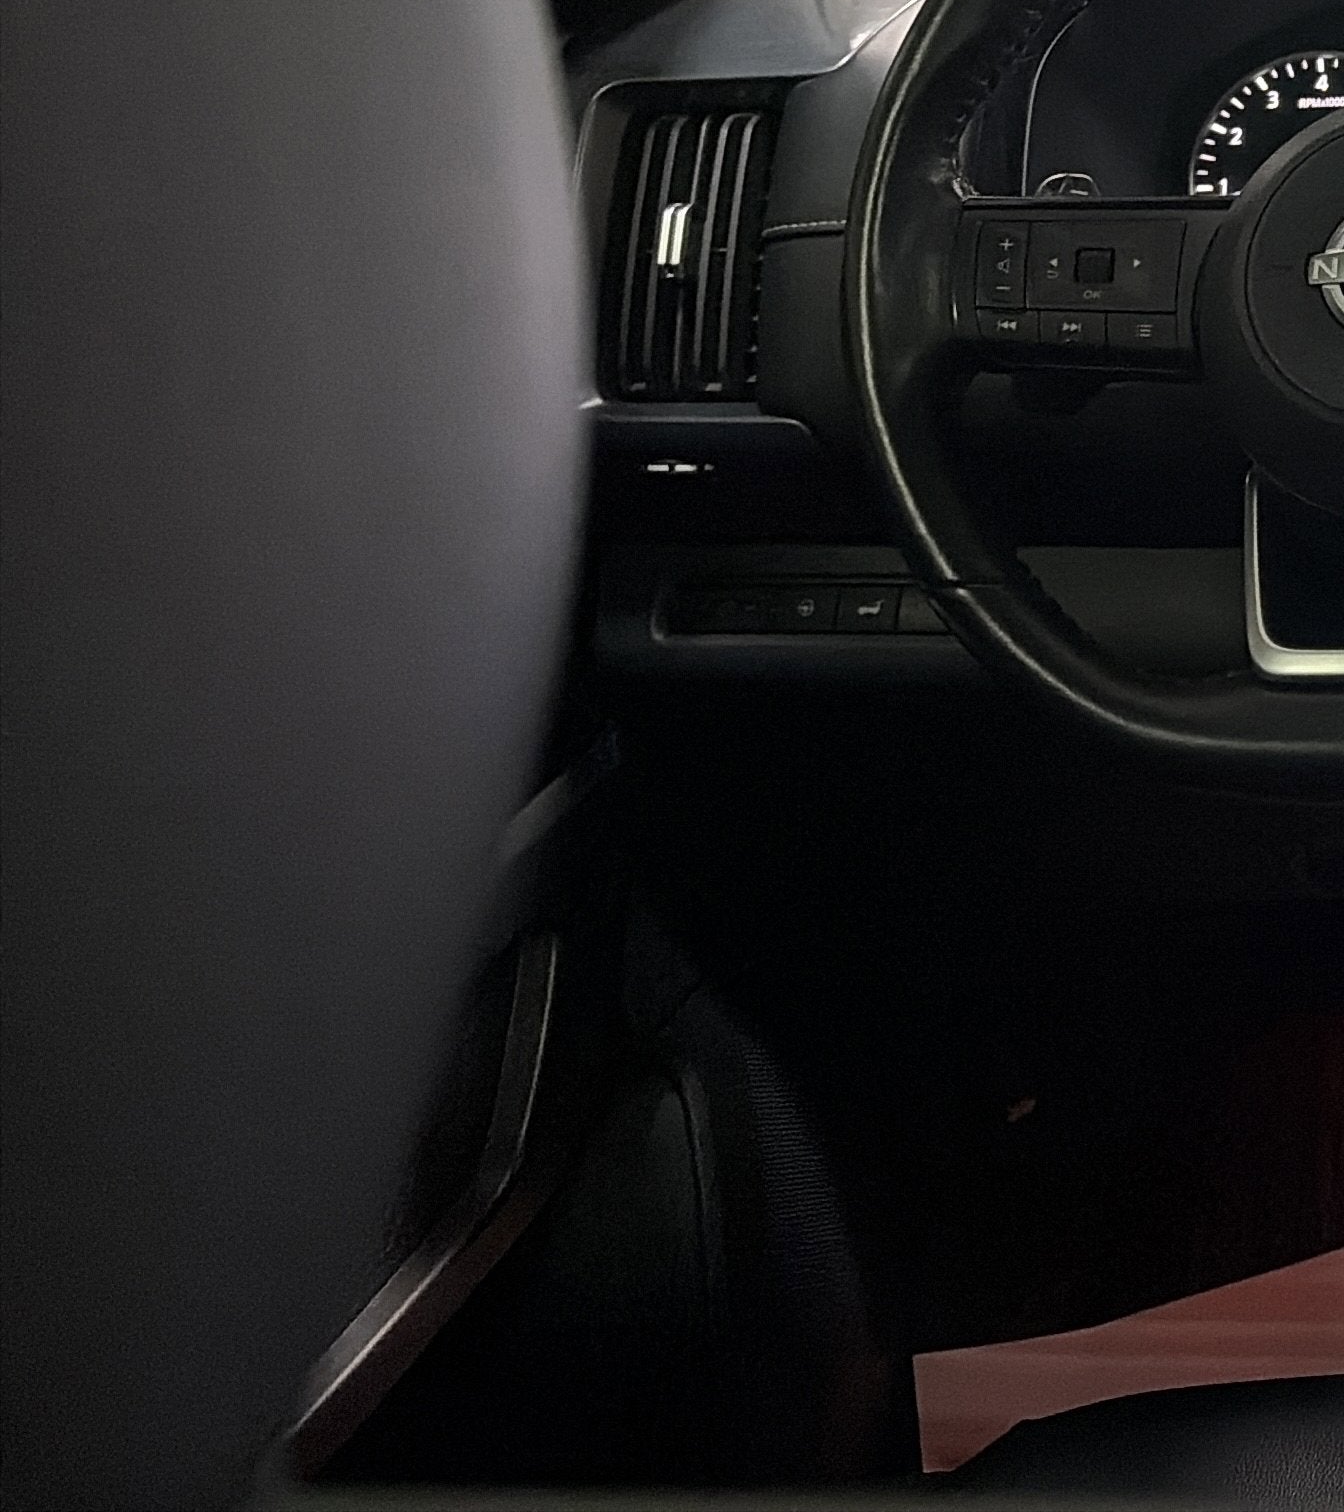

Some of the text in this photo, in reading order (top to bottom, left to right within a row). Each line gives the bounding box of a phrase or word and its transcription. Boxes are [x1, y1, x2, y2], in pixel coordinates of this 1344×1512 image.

[1313, 73, 1330, 92] 4
[1265, 90, 1280, 109] 3
[1227, 127, 1243, 146] 2
[1218, 177, 1229, 196] 1
[1083, 290, 1101, 301] OK
